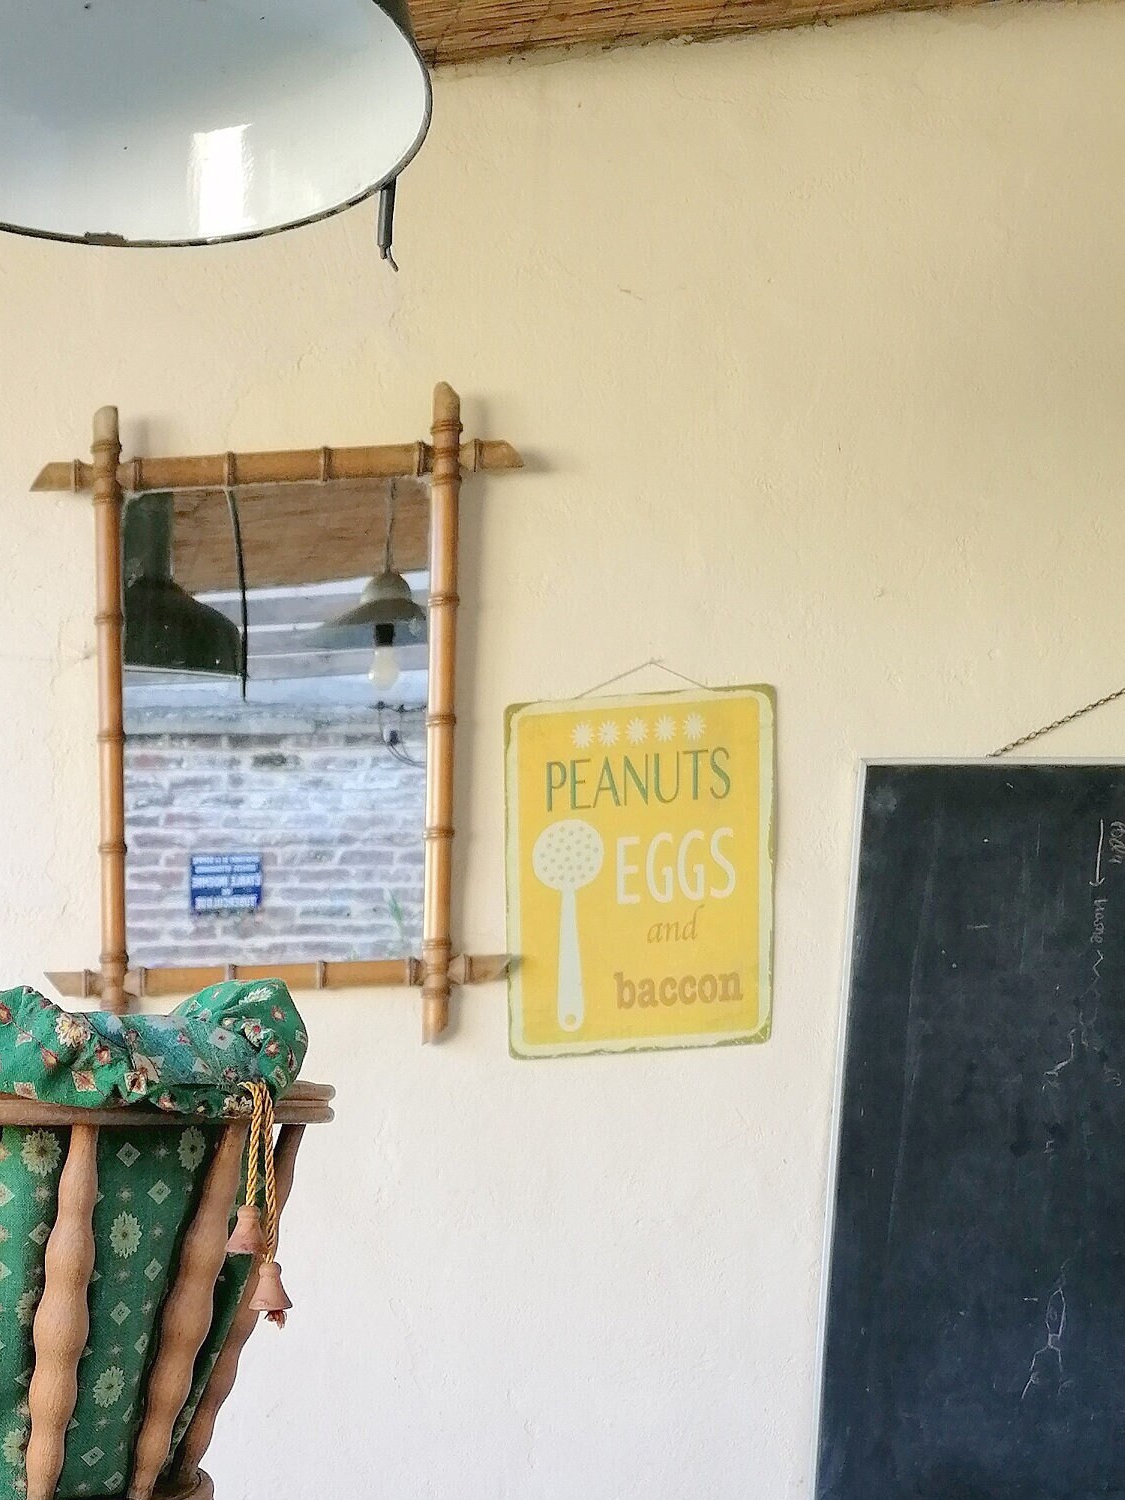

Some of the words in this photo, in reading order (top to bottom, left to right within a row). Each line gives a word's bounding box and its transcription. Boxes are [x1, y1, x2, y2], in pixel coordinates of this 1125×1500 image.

[546, 747, 731, 812] PEANUTS
[616, 827, 736, 905] EGGS
[647, 904, 705, 944] and
[613, 970, 744, 1010] baccon
